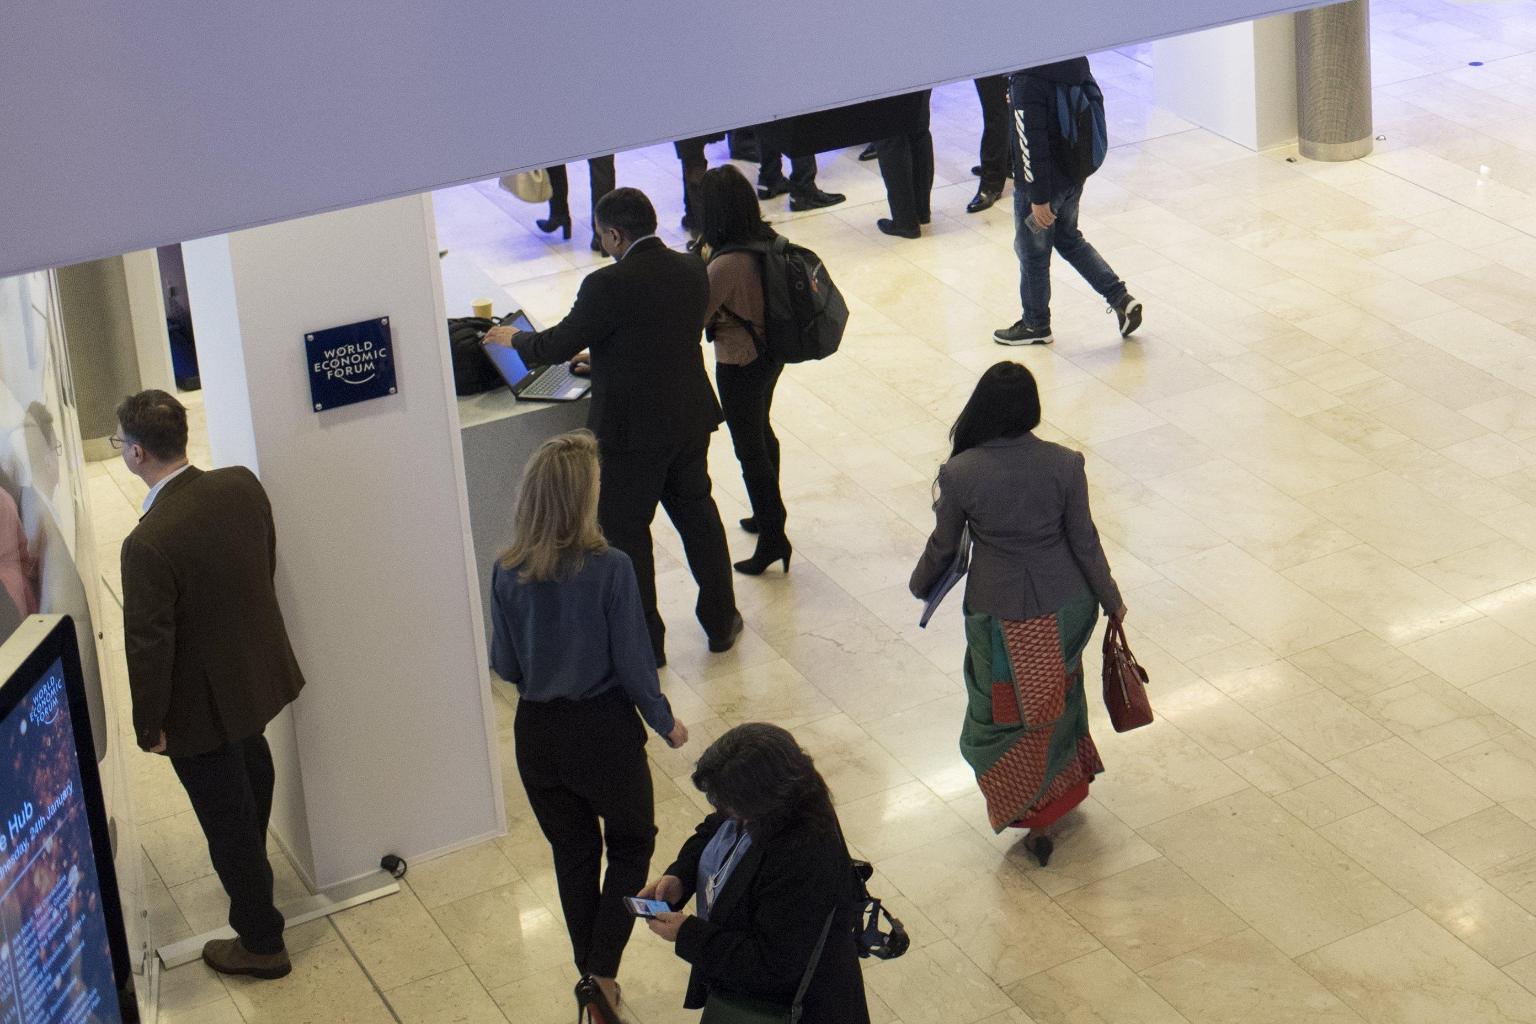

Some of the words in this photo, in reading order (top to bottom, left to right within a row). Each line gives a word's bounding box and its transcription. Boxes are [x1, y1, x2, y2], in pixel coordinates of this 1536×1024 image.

[314, 348, 387, 372] ECONOMIC
[324, 341, 373, 359] WORLD
[327, 362, 375, 380] FORUM
[29, 678, 63, 722] ECONOMIC
[33, 676, 55, 706] WORLD
[36, 697, 59, 727] FORUM
[8, 801, 33, 840] Hub
[29, 816, 46, 836] 24th
[46, 781, 73, 820] January
